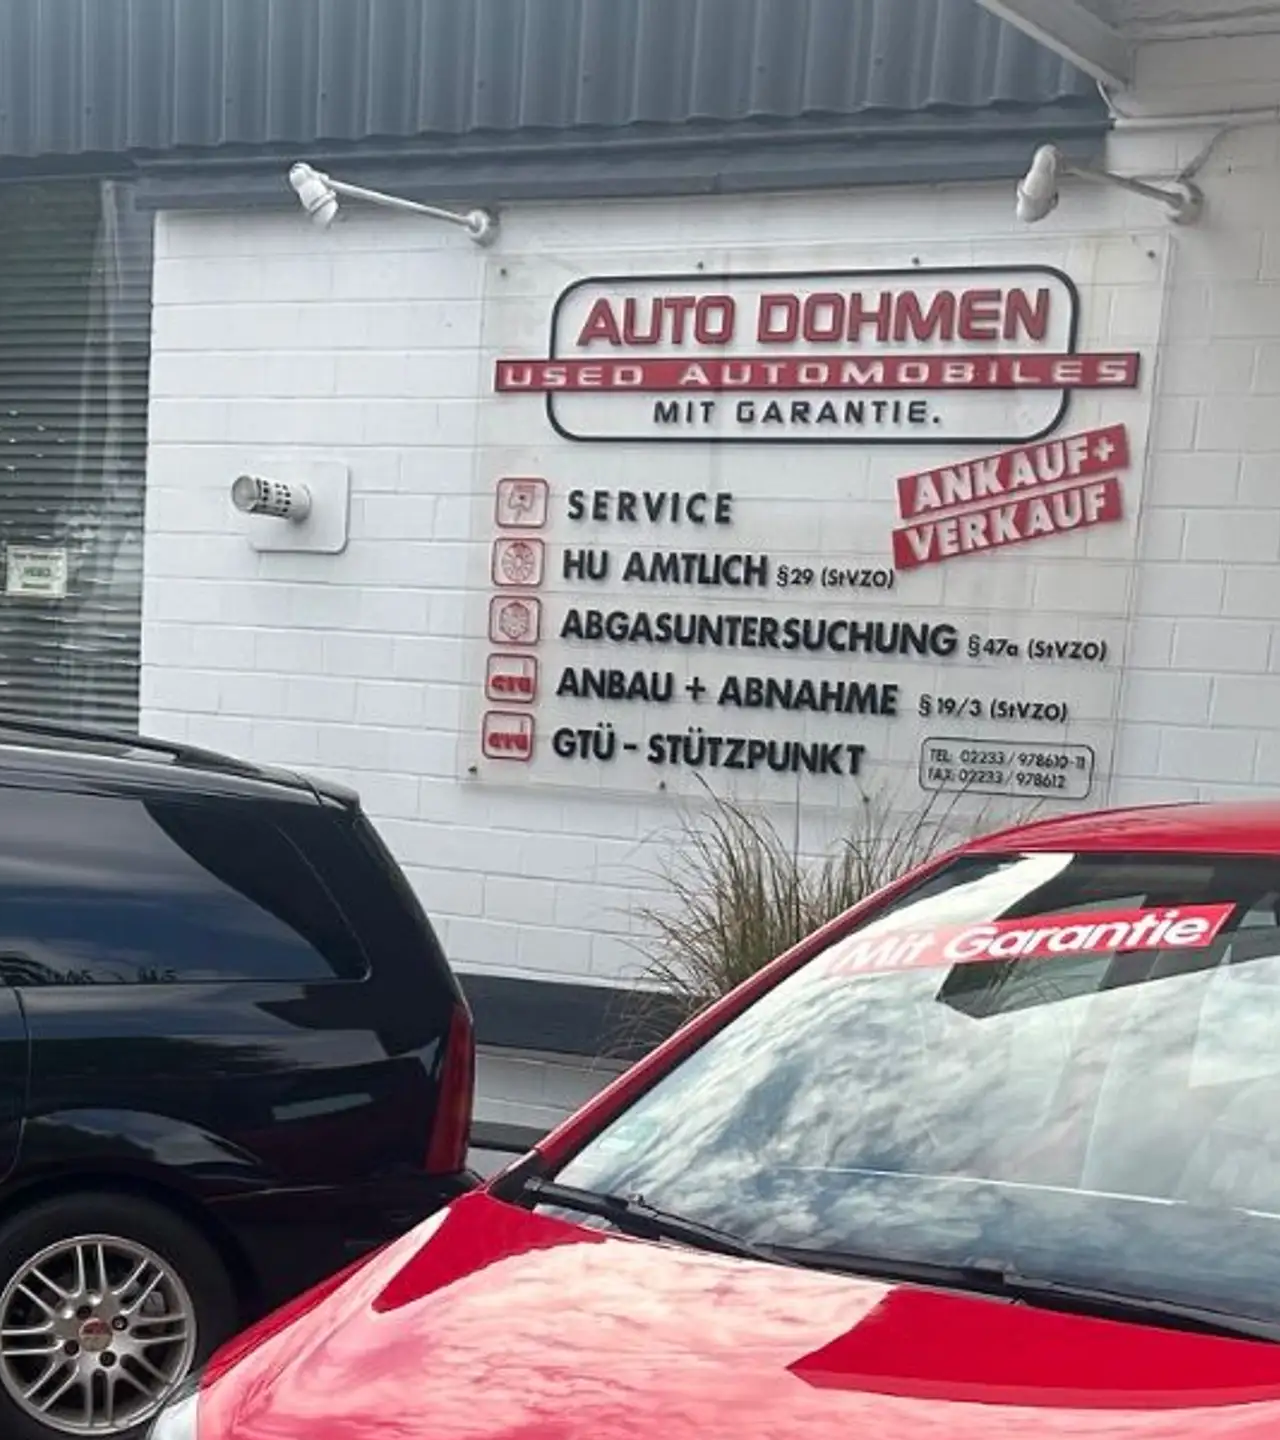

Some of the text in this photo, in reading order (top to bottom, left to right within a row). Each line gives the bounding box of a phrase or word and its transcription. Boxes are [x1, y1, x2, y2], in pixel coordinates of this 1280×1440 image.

[577, 287, 1051, 348] AUTO DOHMEN
[503, 360, 1130, 387] USED AUTOMOBILES
[653, 400, 941, 424] MIT GARANTIE.
[567, 489, 734, 525] SERVICE
[905, 485, 1106, 562] VERKAUF
[562, 549, 609, 581] HU
[622, 551, 769, 587] AMTLICH
[820, 566, 895, 590] (StVZO)
[559, 608, 959, 658] ABGASUNTERSUCHUNG
[1027, 637, 1109, 662] (StVZO)
[555, 667, 675, 702] ANBAU
[684, 675, 707, 701] +
[717, 675, 899, 717] ABNAHME
[990, 698, 1068, 723] (StVZO)
[552, 721, 616, 761] GTÜ
[647, 725, 866, 777] STÜTZPUNKT
[832, 911, 1210, 971] Mit Garantie
